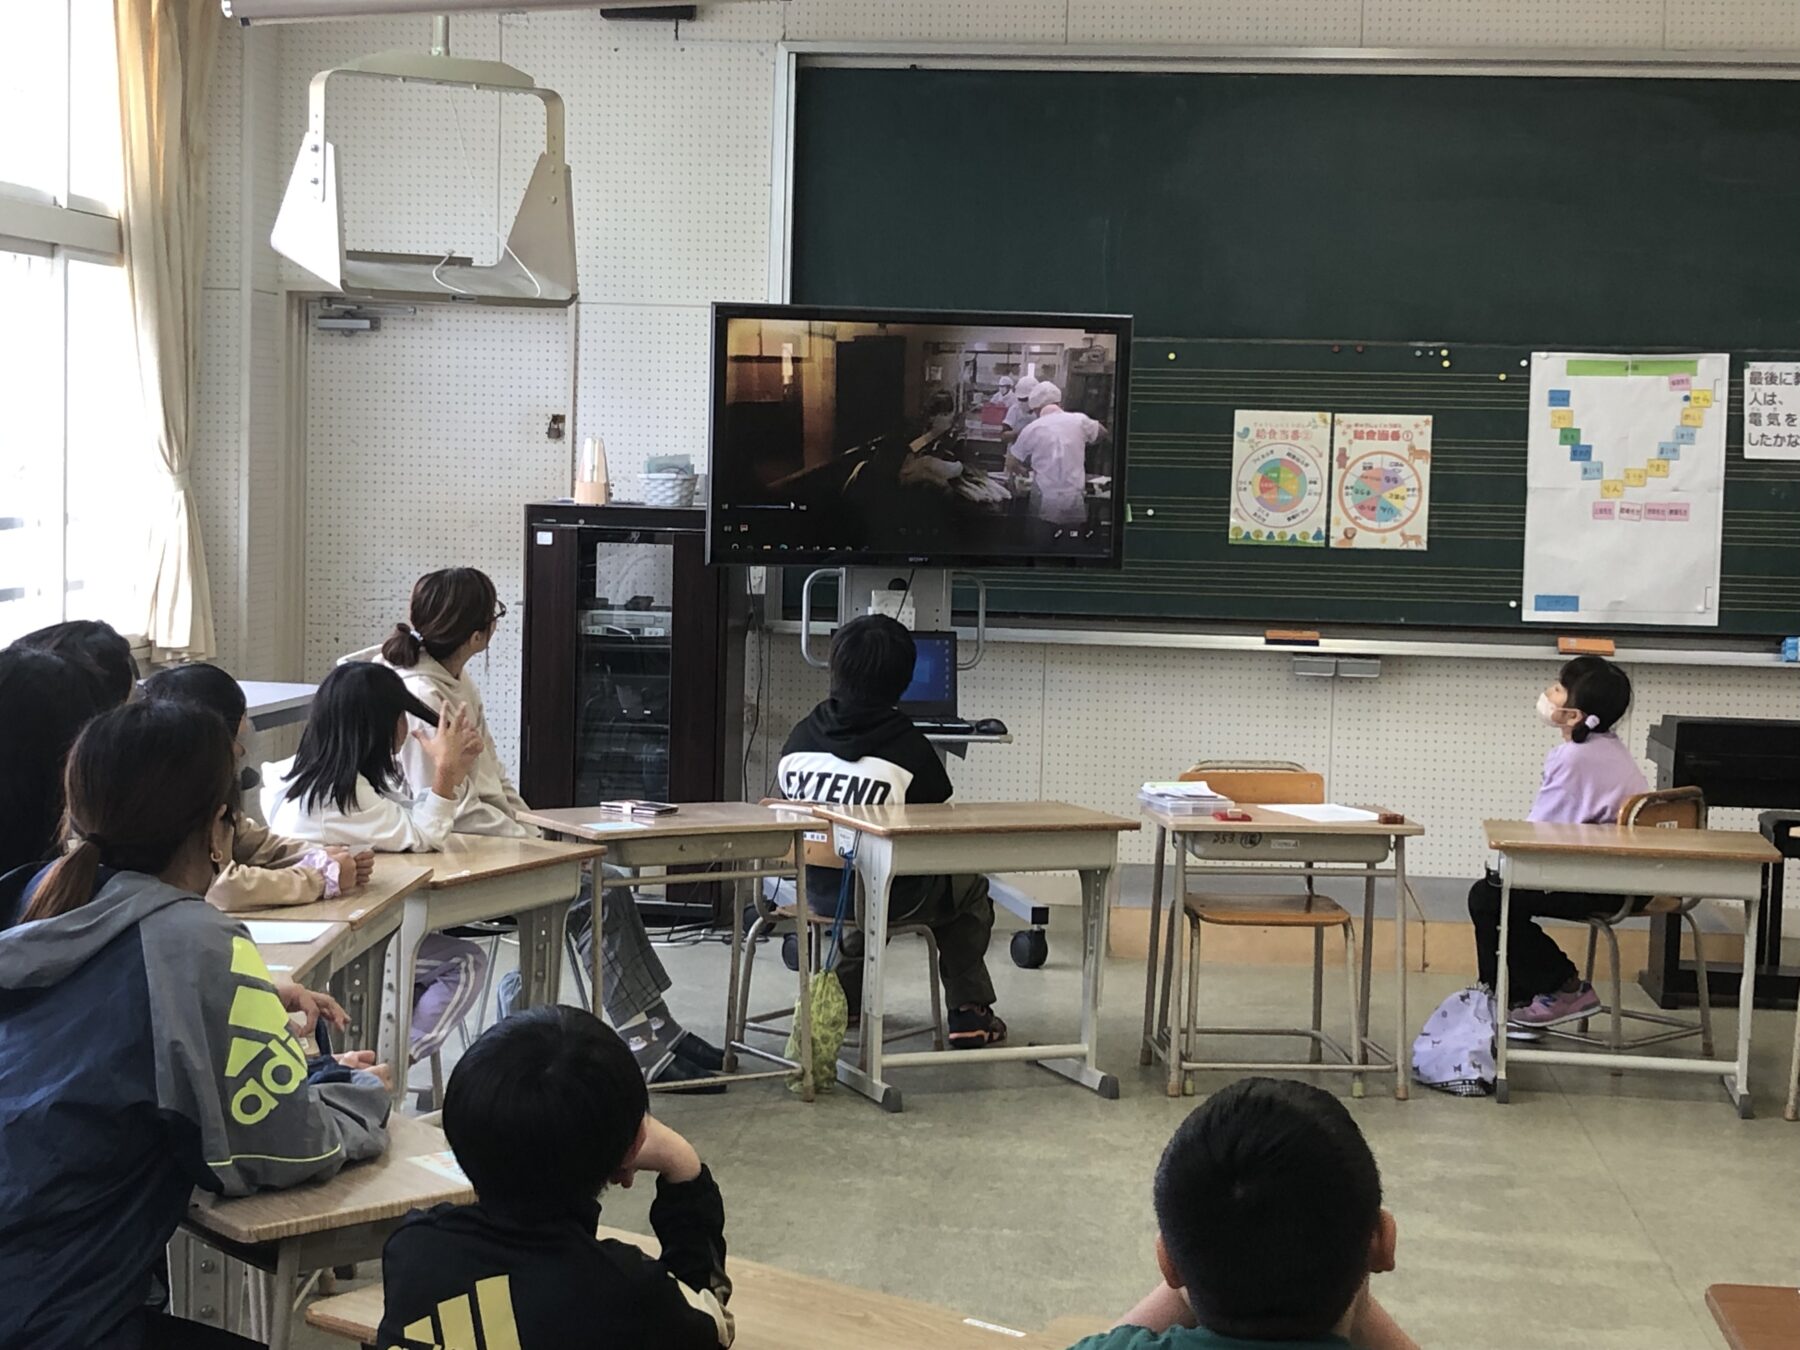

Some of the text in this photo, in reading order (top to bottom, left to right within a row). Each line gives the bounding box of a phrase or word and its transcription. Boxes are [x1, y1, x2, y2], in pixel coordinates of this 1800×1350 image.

[1749, 391, 1783, 406] 人は、
[1749, 412, 1798, 427] 電気を
[1748, 432, 1800, 447] したかな
[785, 770, 892, 806] EXTEND
